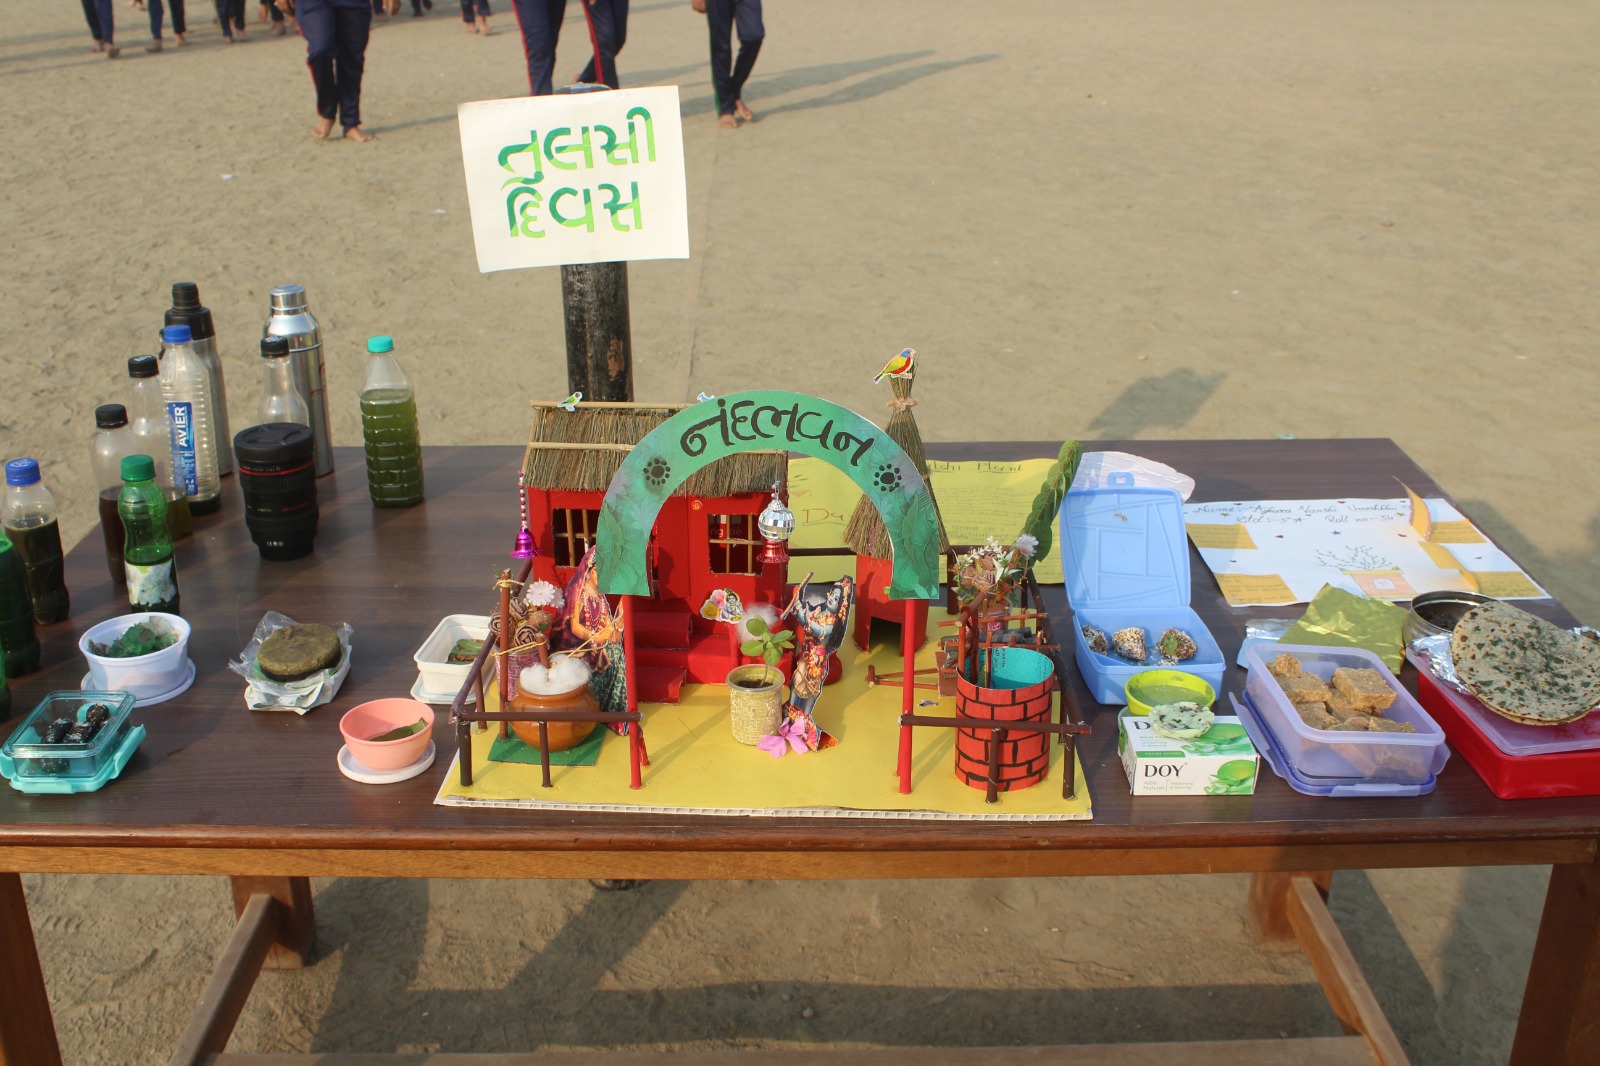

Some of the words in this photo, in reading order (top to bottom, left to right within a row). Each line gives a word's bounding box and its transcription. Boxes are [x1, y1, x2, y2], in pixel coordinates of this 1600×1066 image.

[497, 106, 656, 191] તુલસી
[506, 181, 643, 239] દિવસ
[977, 461, 1024, 472] Plant
[1324, 515, 1349, 523] Roll
[1144, 764, 1184, 778] DOY
